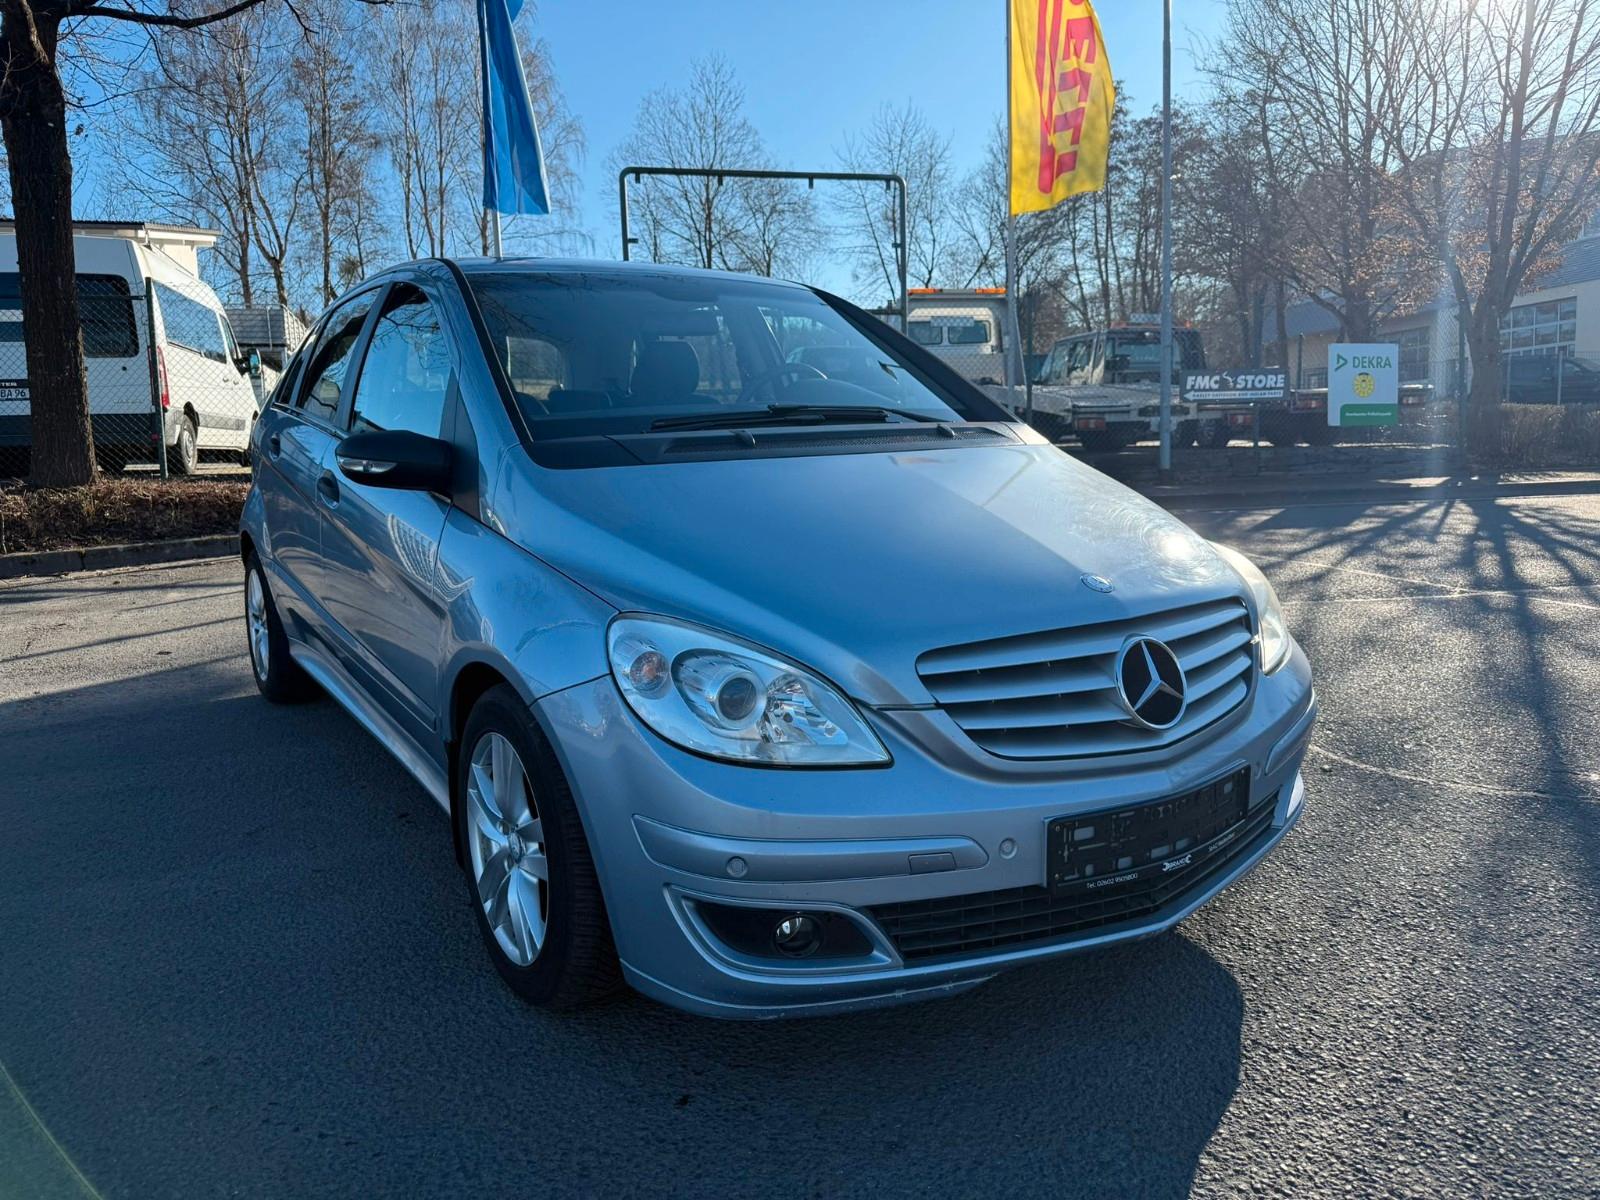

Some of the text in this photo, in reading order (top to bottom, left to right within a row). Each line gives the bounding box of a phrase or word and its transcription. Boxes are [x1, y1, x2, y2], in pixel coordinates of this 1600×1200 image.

[1352, 356, 1392, 369] DEKRA
[1186, 374, 1285, 390] FMC STORE
[15, 389, 26, 398] 96
